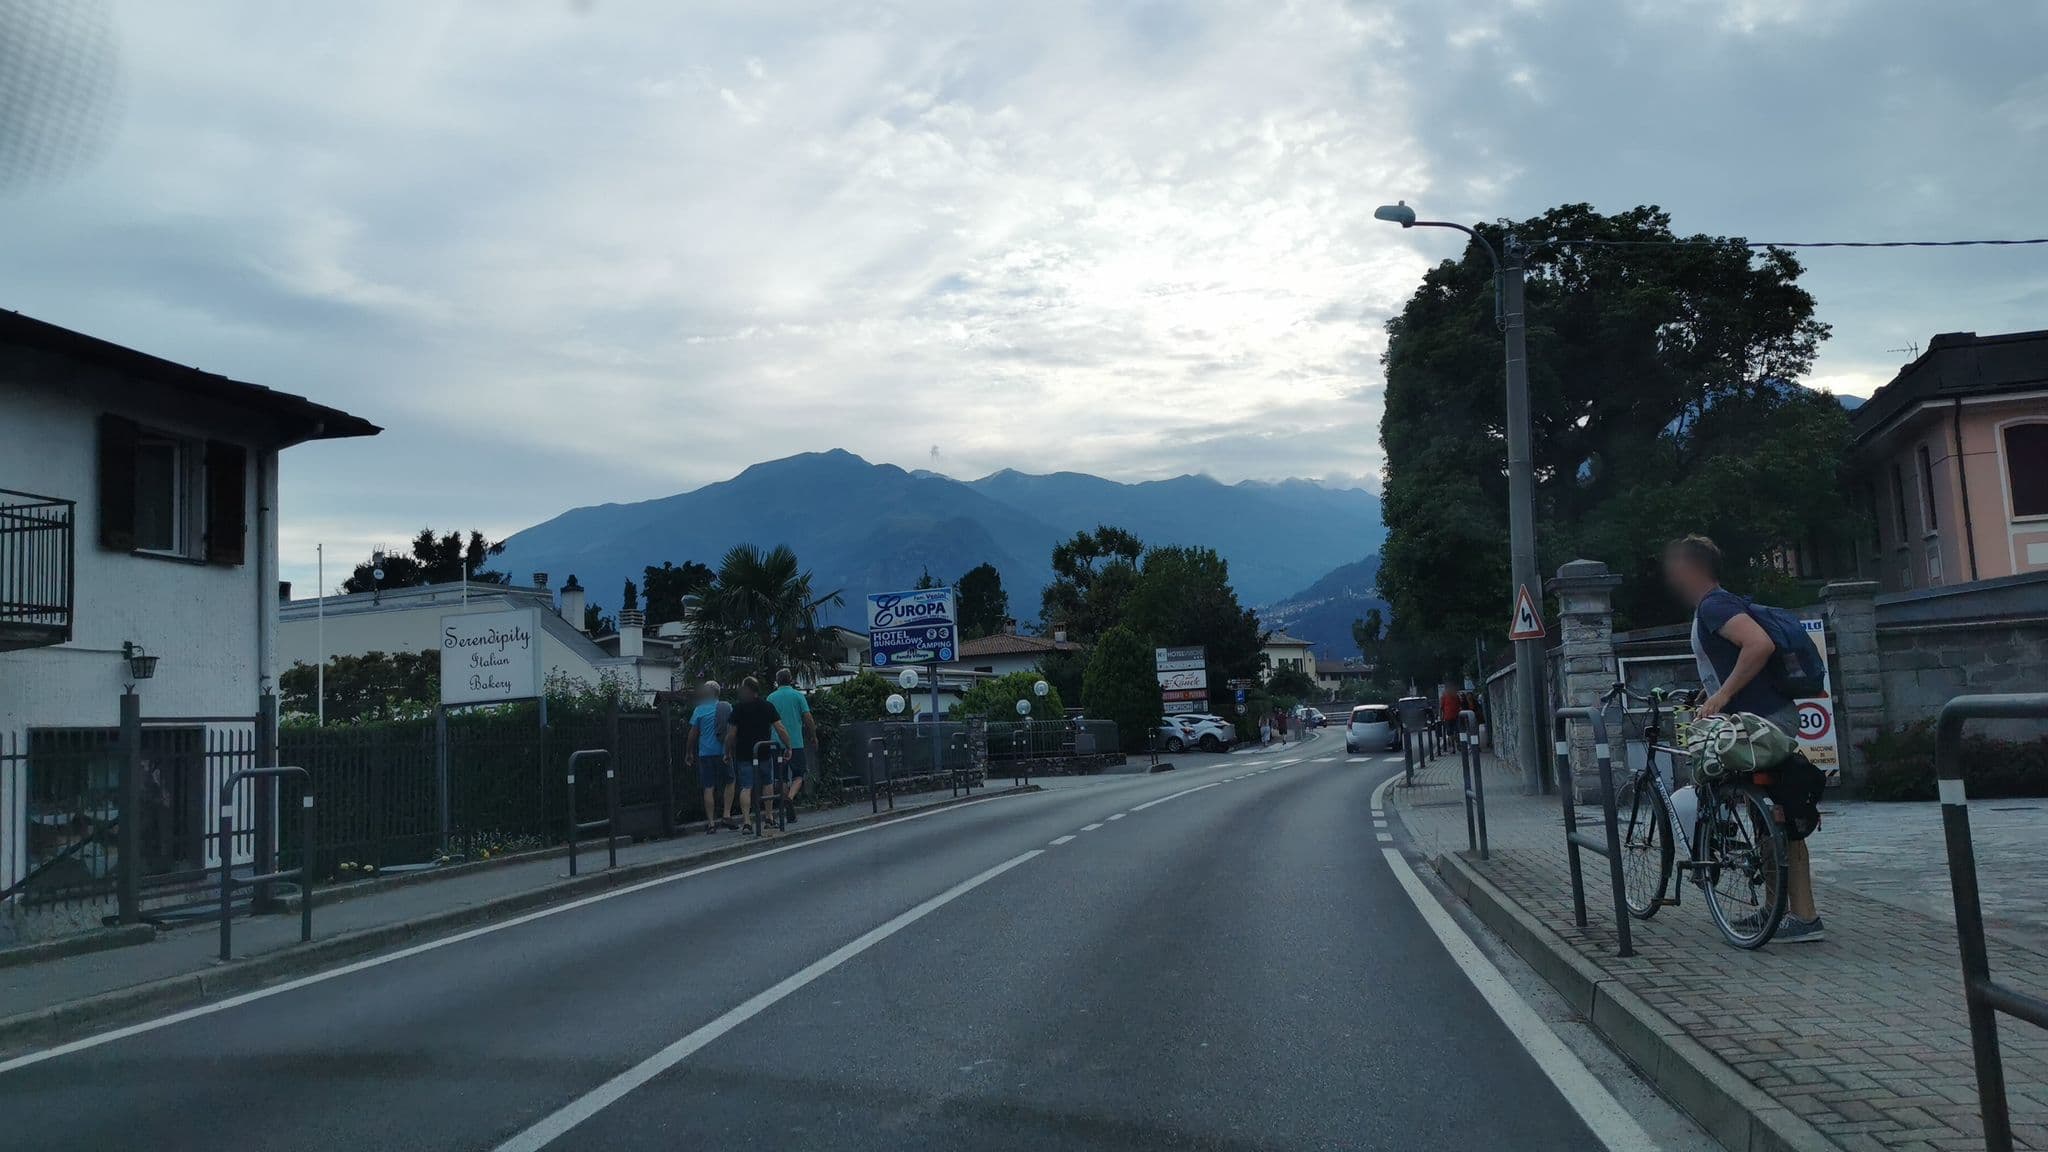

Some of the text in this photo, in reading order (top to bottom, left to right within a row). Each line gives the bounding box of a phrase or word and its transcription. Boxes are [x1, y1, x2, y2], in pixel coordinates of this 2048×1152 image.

[874, 594, 946, 627] EUROPA
[444, 626, 531, 653] Serendipity
[873, 630, 910, 641] HOTEL
[873, 637, 923, 648] BUNGALOWS
[916, 640, 952, 650] CAMPING
[469, 652, 511, 669] Italian
[469, 675, 512, 694] Bakery
[1799, 713, 1822, 729] 30
